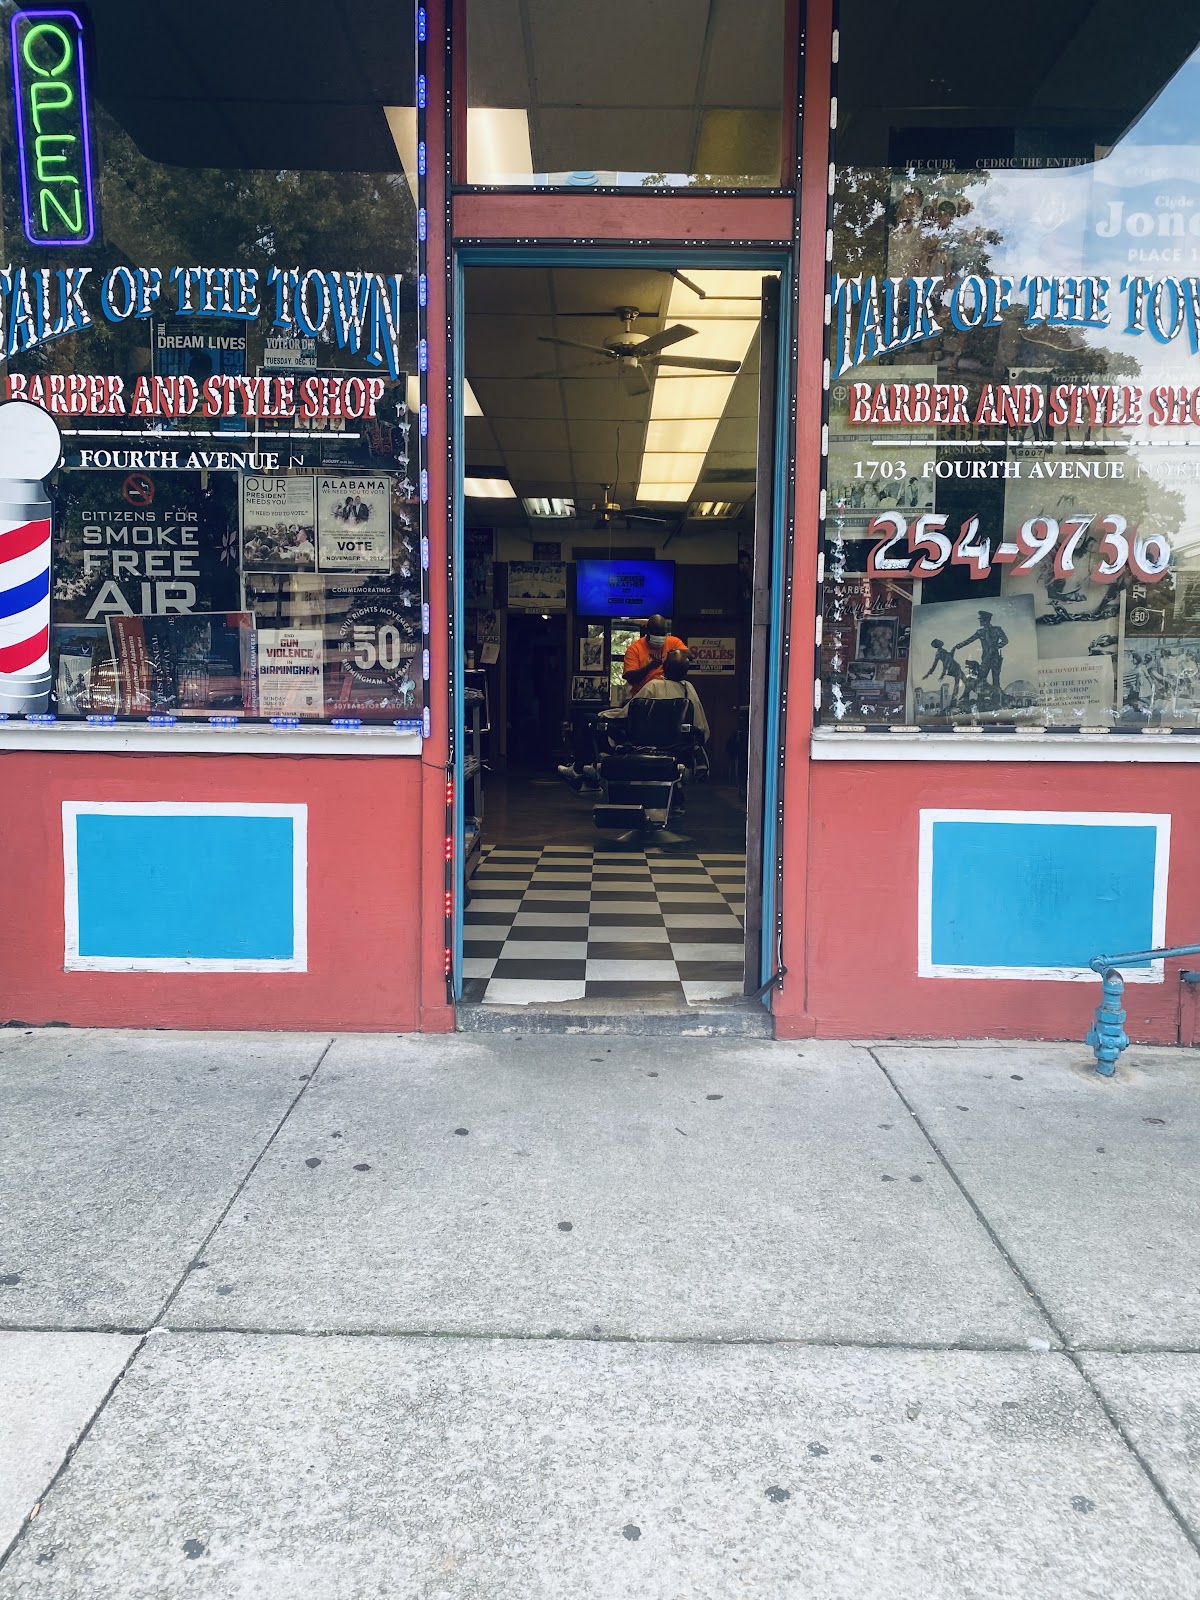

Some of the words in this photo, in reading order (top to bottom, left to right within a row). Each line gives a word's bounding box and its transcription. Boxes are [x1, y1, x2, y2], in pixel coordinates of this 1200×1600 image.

[23, 24, 82, 232] OPEN
[905, 159, 923, 169] ICE
[927, 159, 956, 169] CUBE
[975, 158, 1017, 168] CEDRIC
[1020, 158, 1042, 168] THE
[1128, 248, 1182, 262] PLACE
[101, 266, 162, 323] OF
[169, 266, 260, 321] THE
[267, 266, 402, 381] TOWN
[832, 272, 943, 379] TALK
[950, 274, 1014, 331] OF
[1019, 274, 1112, 330] THE
[158, 336, 203, 349] DREAM
[209, 337, 246, 350] LIVES
[266, 338, 288, 349] VOTE
[288, 339, 300, 350] OR
[302, 339, 316, 350] DIE
[223, 351, 243, 365] 50
[4, 373, 126, 416] BARBER
[129, 375, 199, 418] AND
[202, 374, 295, 418] STYLE
[300, 376, 385, 419] SHOP
[848, 382, 970, 426] BARBER
[972, 383, 1044, 427] AND
[1048, 383, 1143, 427] STYLE
[80, 450, 179, 468] FOURTH
[185, 451, 279, 469] AVENUE
[854, 460, 908, 480] 1703
[921, 461, 1022, 479] FOURTH
[1028, 461, 1125, 479] AVENUE
[246, 478, 286, 492] OUR
[322, 481, 385, 489] ALABAMA
[82, 511, 156, 522] CITIZENS
[164, 511, 198, 522] FOR
[83, 526, 199, 545] SMOKE
[337, 541, 372, 551] VOTE
[866, 511, 1171, 583] 254-9736
[83, 550, 200, 577] FREE
[85, 580, 197, 620] AIR
[340, 618, 354, 636] CIVIL
[352, 606, 378, 621] RIGHTS
[380, 607, 414, 637] MOVEMENT
[1134, 611, 1145, 621] 50
[118, 623, 128, 657] Observance
[280, 639, 298, 647] GUN
[354, 625, 400, 669] 50
[702, 639, 722, 647] Elect
[128, 636, 137, 662] Alabama
[266, 649, 313, 658] VIOLENCE
[403, 643, 417, 652] 2013
[690, 646, 734, 660] SCALES
[260, 666, 320, 675] BIRMINGHAM
[387, 658, 414, 683] ALABAMA
